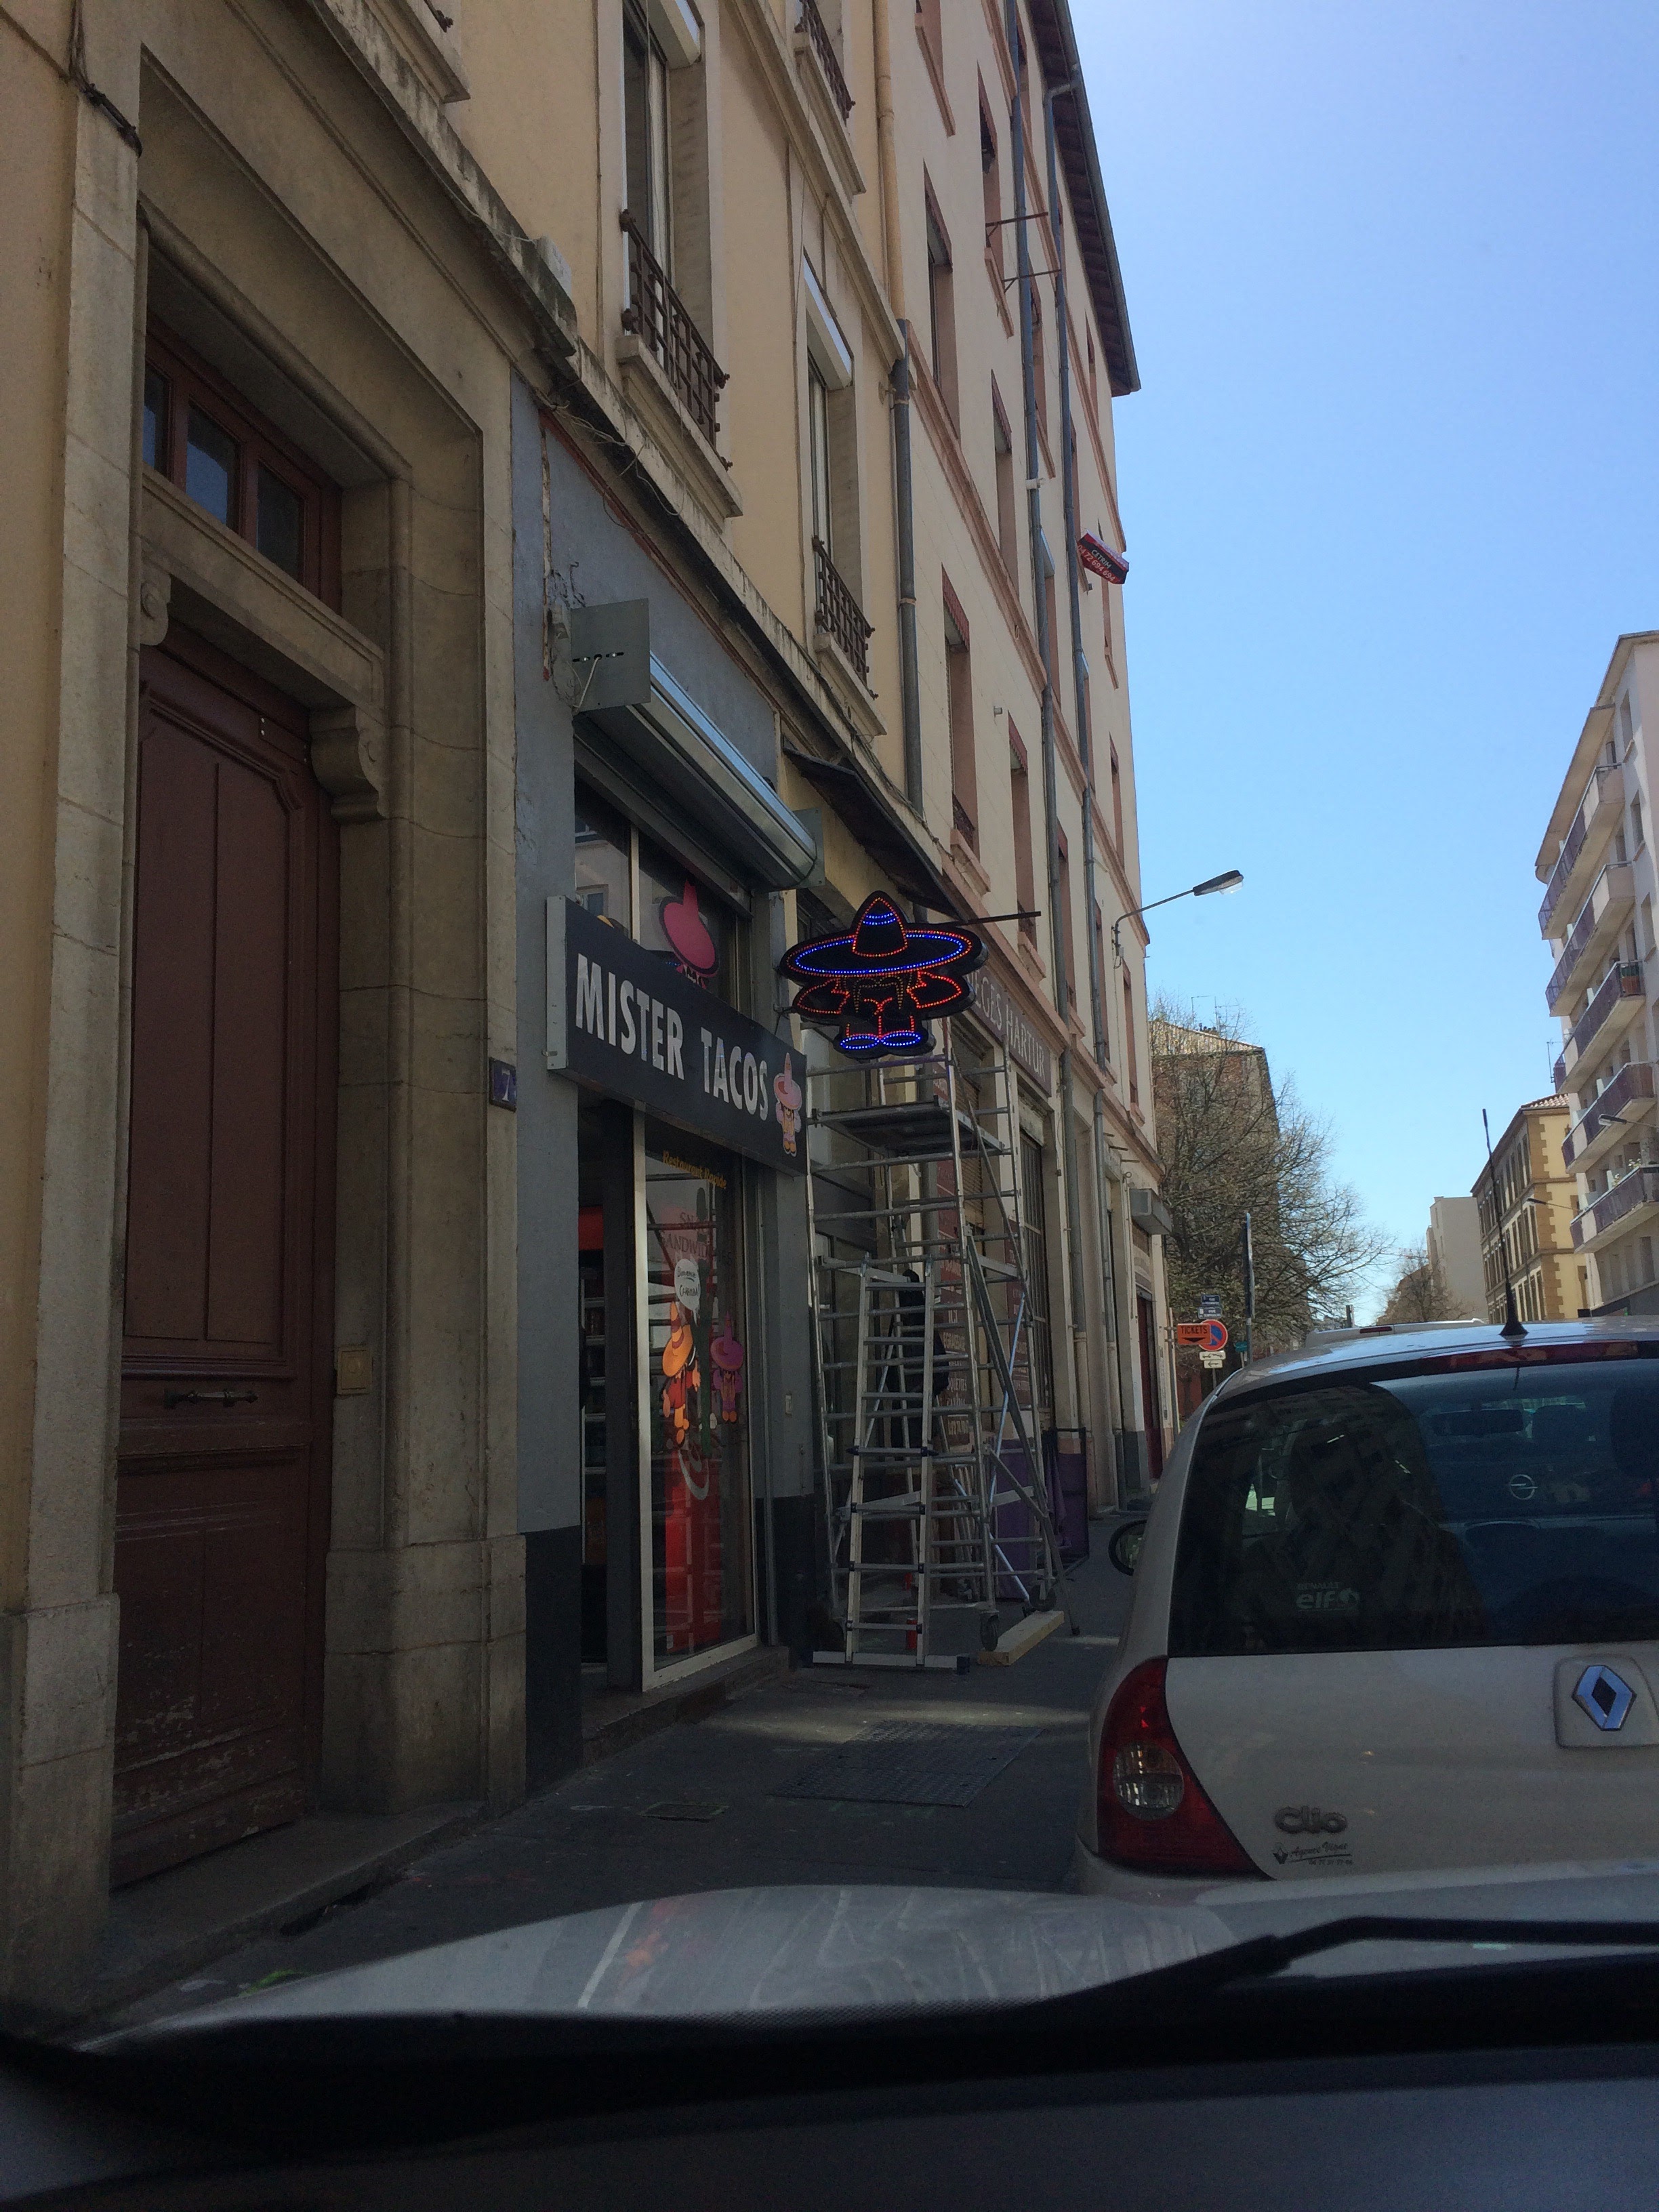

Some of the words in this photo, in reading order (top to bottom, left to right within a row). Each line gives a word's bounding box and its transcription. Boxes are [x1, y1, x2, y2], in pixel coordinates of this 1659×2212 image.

[1084, 553, 1094, 562] 72
[1092, 560, 1103, 571] 694
[1103, 570, 1115, 581] 694
[1092, 550, 1111, 569] CETRIM
[575, 952, 684, 1080] MISTER
[701, 1026, 769, 1122] TACOS
[1006, 1004, 1046, 1082] HARTUR
[663, 1149, 703, 1180] Restaurant
[1180, 1325, 1208, 1334] TICKETS
[1296, 1590, 1336, 1610] elf
